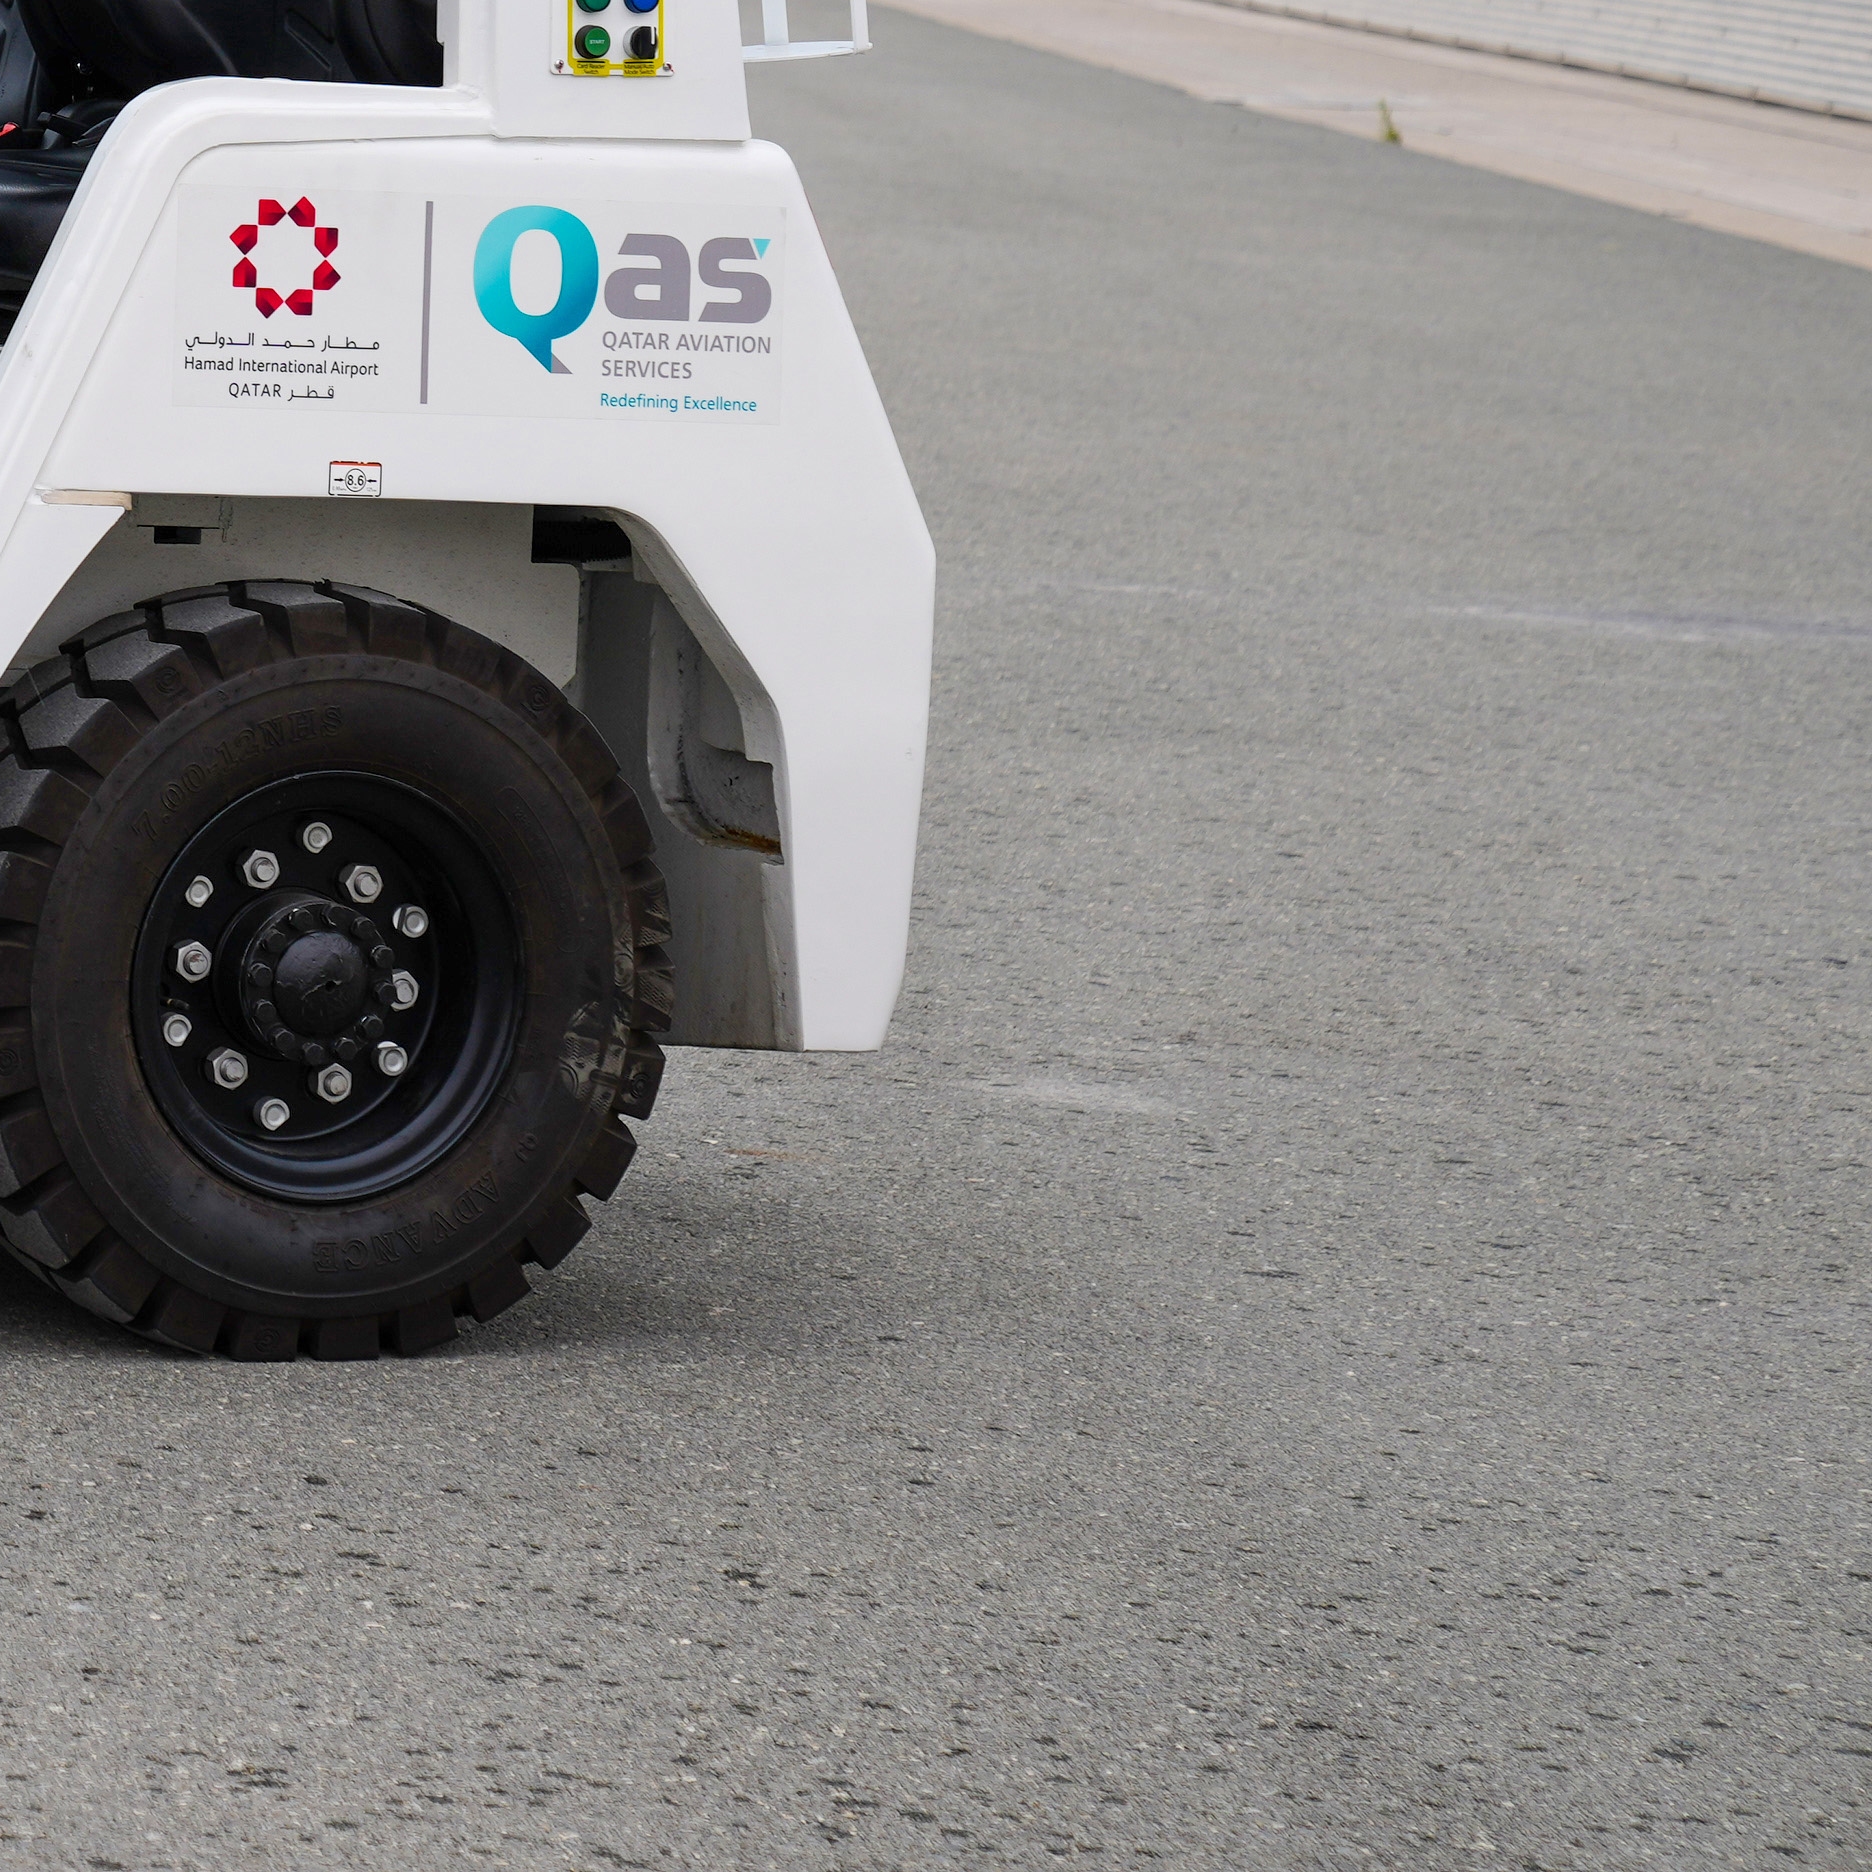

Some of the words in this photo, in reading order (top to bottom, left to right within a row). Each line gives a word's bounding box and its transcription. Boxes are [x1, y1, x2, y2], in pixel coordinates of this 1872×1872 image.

[473, 205, 773, 375] Qas
[185, 331, 255, 351] الدولي
[262, 337, 316, 348] حمد
[321, 335, 380, 353] مطار
[602, 331, 670, 350] QATAR
[675, 333, 772, 354] AVIATION
[184, 356, 234, 371] Hamad
[238, 358, 327, 375] International
[330, 360, 380, 378] Airport
[601, 359, 693, 380] SERVICES
[228, 382, 282, 398] QATAR
[287, 385, 335, 402] قطر
[600, 392, 678, 412] Redefining
[684, 396, 758, 412] Excellence
[347, 474, 365, 486] 8.6
[312, 1169, 500, 1273] ADVANCE
